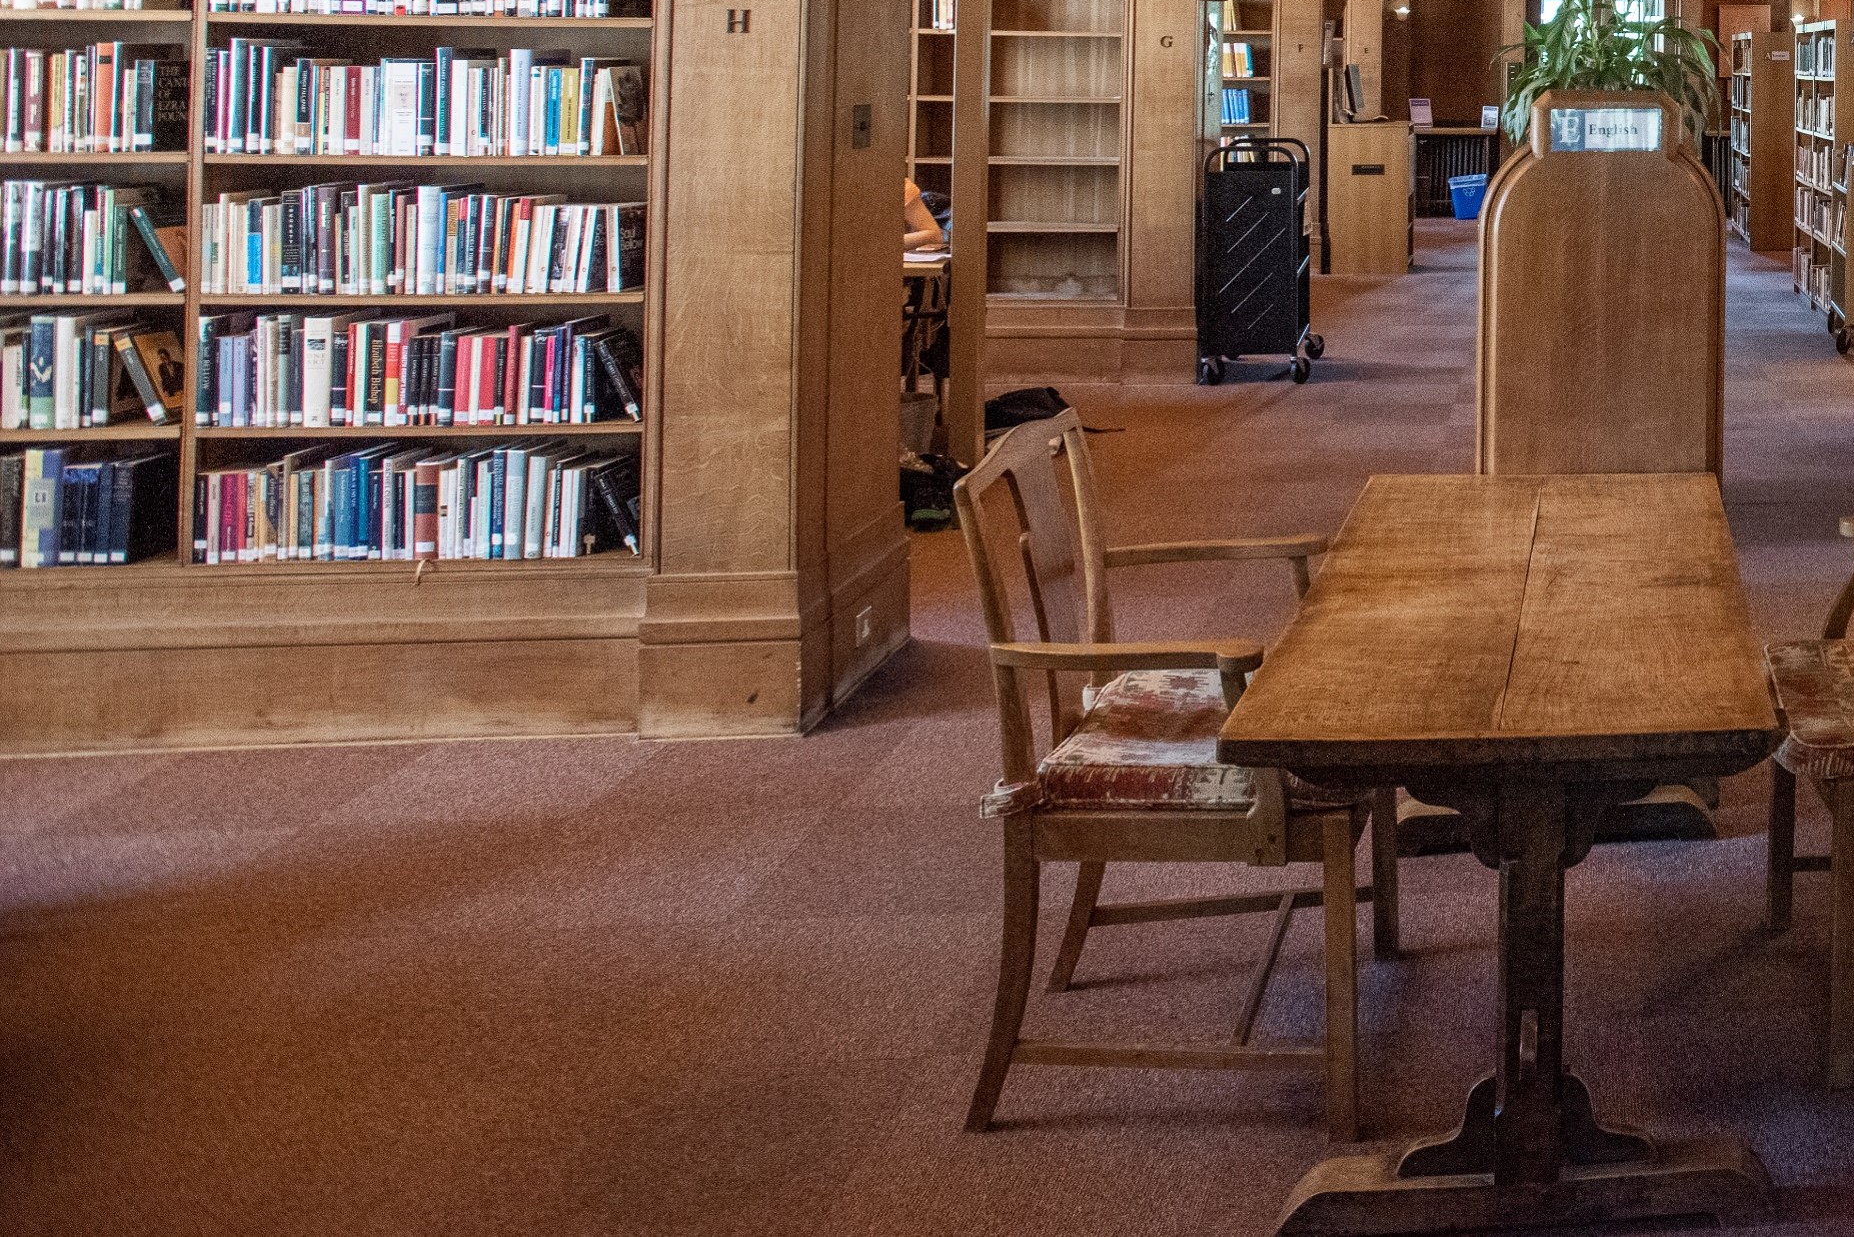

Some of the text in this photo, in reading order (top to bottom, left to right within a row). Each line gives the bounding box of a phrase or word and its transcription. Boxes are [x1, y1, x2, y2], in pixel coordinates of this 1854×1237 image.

[727, 9, 751, 34] H
[1160, 35, 1173, 49] G
[1298, 44, 1304, 53] F
[1558, 116, 1638, 144] E English
[368, 340, 383, 404] Elizabeth Bishop
